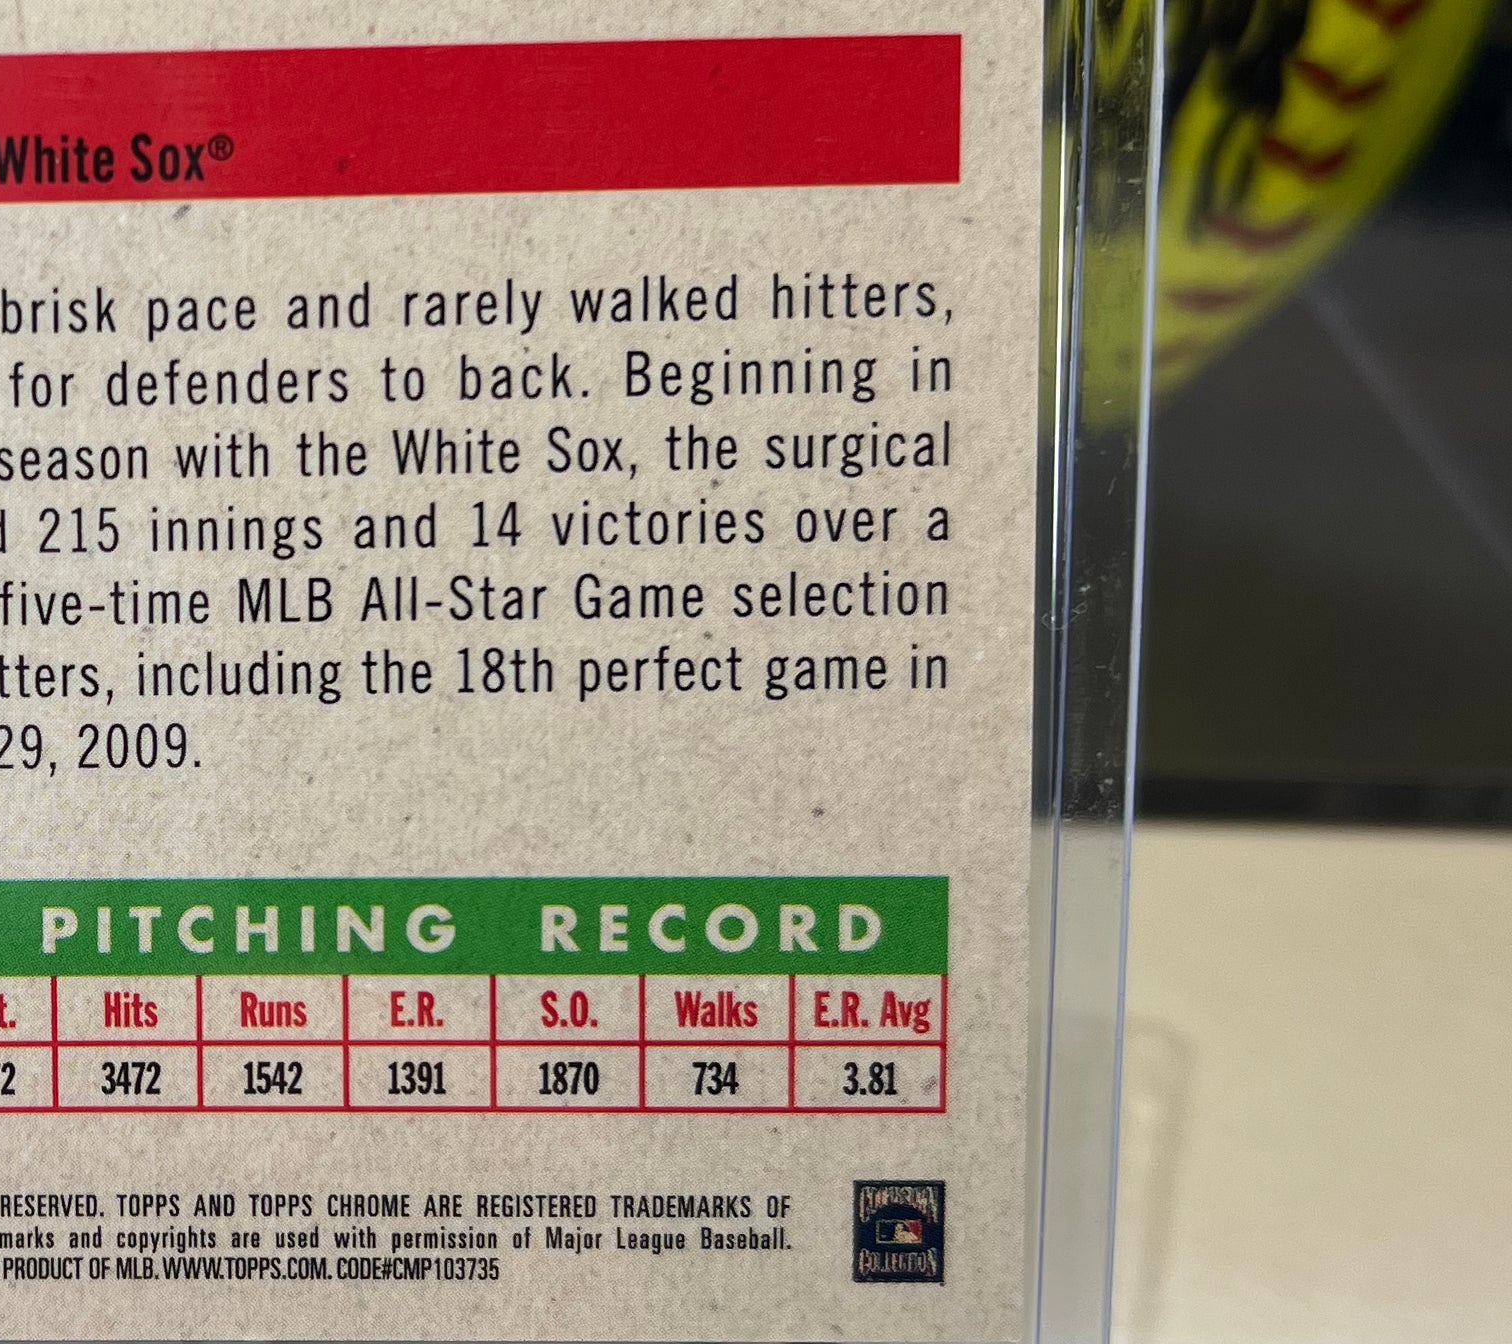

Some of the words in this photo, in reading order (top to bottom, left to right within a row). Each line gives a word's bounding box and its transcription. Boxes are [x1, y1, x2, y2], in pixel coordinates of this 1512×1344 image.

[1, 286, 116, 335] brisk
[148, 295, 256, 341] pace
[287, 281, 370, 330] and
[404, 278, 542, 336] rarely
[570, 273, 737, 324] walked
[772, 272, 952, 325] hitters,
[8, 361, 75, 408] for
[106, 357, 349, 407] defenders
[380, 357, 425, 402] to
[460, 352, 589, 401] back.
[626, 347, 877, 406] Beginning
[912, 345, 951, 392] in
[175, 432, 269, 479] with
[296, 430, 367, 477] the
[392, 428, 520, 475] White
[547, 425, 637, 480] Sox,
[665, 423, 738, 471] the
[765, 420, 950, 479] surgical
[238, 577, 333, 624] MLB
[360, 574, 548, 622] All-Star
[574, 572, 704, 620] Game
[733, 569, 948, 618] selection
[78, 722, 201, 769] 2009.
[42, 905, 455, 954] PITCHING
[541, 904, 882, 953] RECORD
[103, 991, 159, 1029] Hits
[239, 991, 308, 1029] Runs
[390, 990, 445, 1029] E.R.
[540, 990, 599, 1029] S.O.
[675, 991, 759, 1029] Walks
[814, 991, 869, 1029] E.R.
[880, 991, 931, 1035] Avg
[101, 1061, 162, 1096] 3472
[243, 1061, 303, 1095] 1542
[388, 1061, 447, 1095] 1391
[538, 1061, 600, 1096] 1870
[692, 1061, 740, 1096] 734
[842, 1061, 899, 1096] 3.81
[0, 1195, 105, 1218] RESERVED.
[116, 1194, 180, 1218] TOPPS
[193, 1194, 236, 1218] AND
[248, 1194, 313, 1218] TOPPS
[327, 1194, 410, 1218] CHROME
[423, 1194, 463, 1218] ARE
[476, 1194, 597, 1219] REGISTERED
[610, 1194, 752, 1219] TRADEMARKS
[766, 1195, 791, 1219] OF
[69, 1226, 103, 1249] and
[116, 1226, 217, 1254] copyrights
[231, 1231, 261, 1249] are
[275, 1226, 320, 1249] used
[333, 1225, 377, 1249] with
[391, 1225, 498, 1254] permission
[512, 1226, 532, 1249] of
[545, 1226, 603, 1255] Major
[616, 1226, 686, 1256] League
[700, 1226, 792, 1251] Baseball.
[2, 1258, 84, 1281] PRODUCT
[88, 1257, 111, 1280] OF
[115, 1258, 160, 1282] MLB.
[162, 1257, 333, 1281] WWW.TOPPS.COM.
[336, 1257, 500, 1281] CODE#CMP103735
